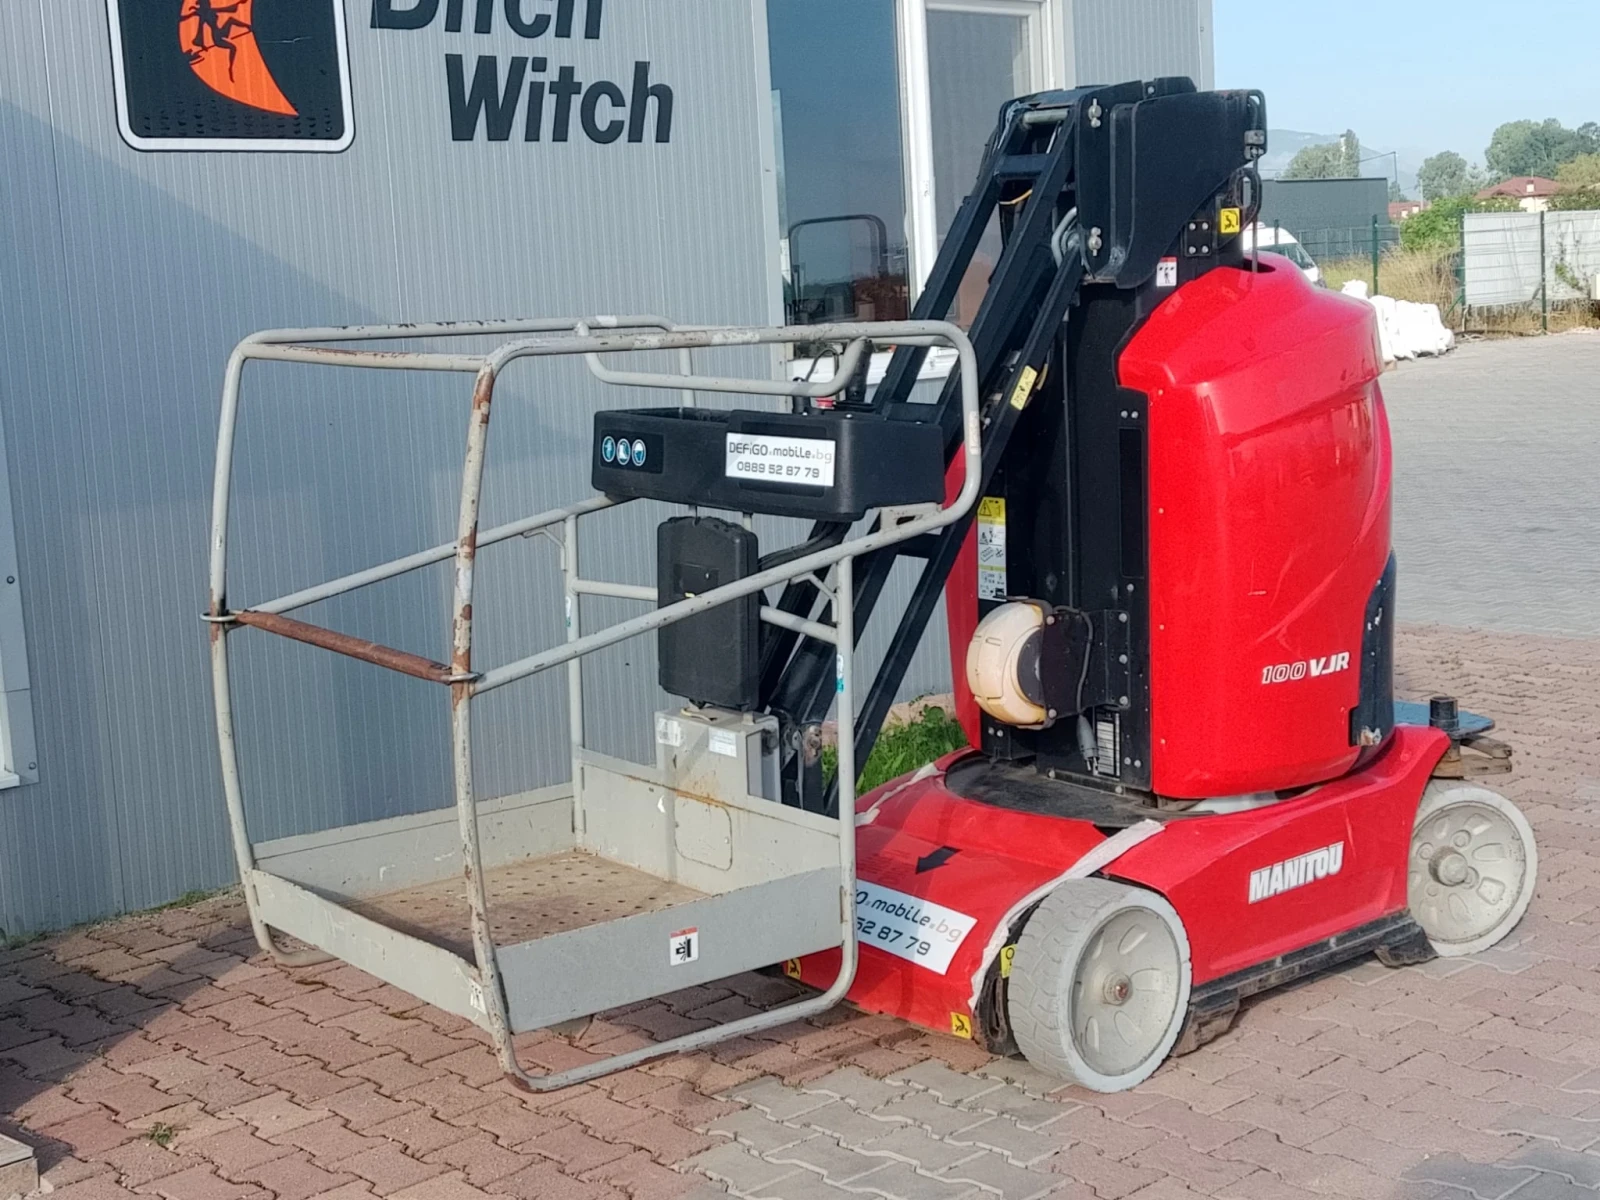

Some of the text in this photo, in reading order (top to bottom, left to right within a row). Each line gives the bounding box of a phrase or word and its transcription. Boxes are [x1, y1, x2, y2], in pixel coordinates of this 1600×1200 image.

[445, 53, 674, 144] Witch
[737, 461, 820, 479] 0889 52 87 79
[1261, 651, 1350, 685] 100 VJR
[1248, 840, 1345, 905] MANITOU
[877, 926, 904, 943] 87
[905, 936, 931, 956] 79
